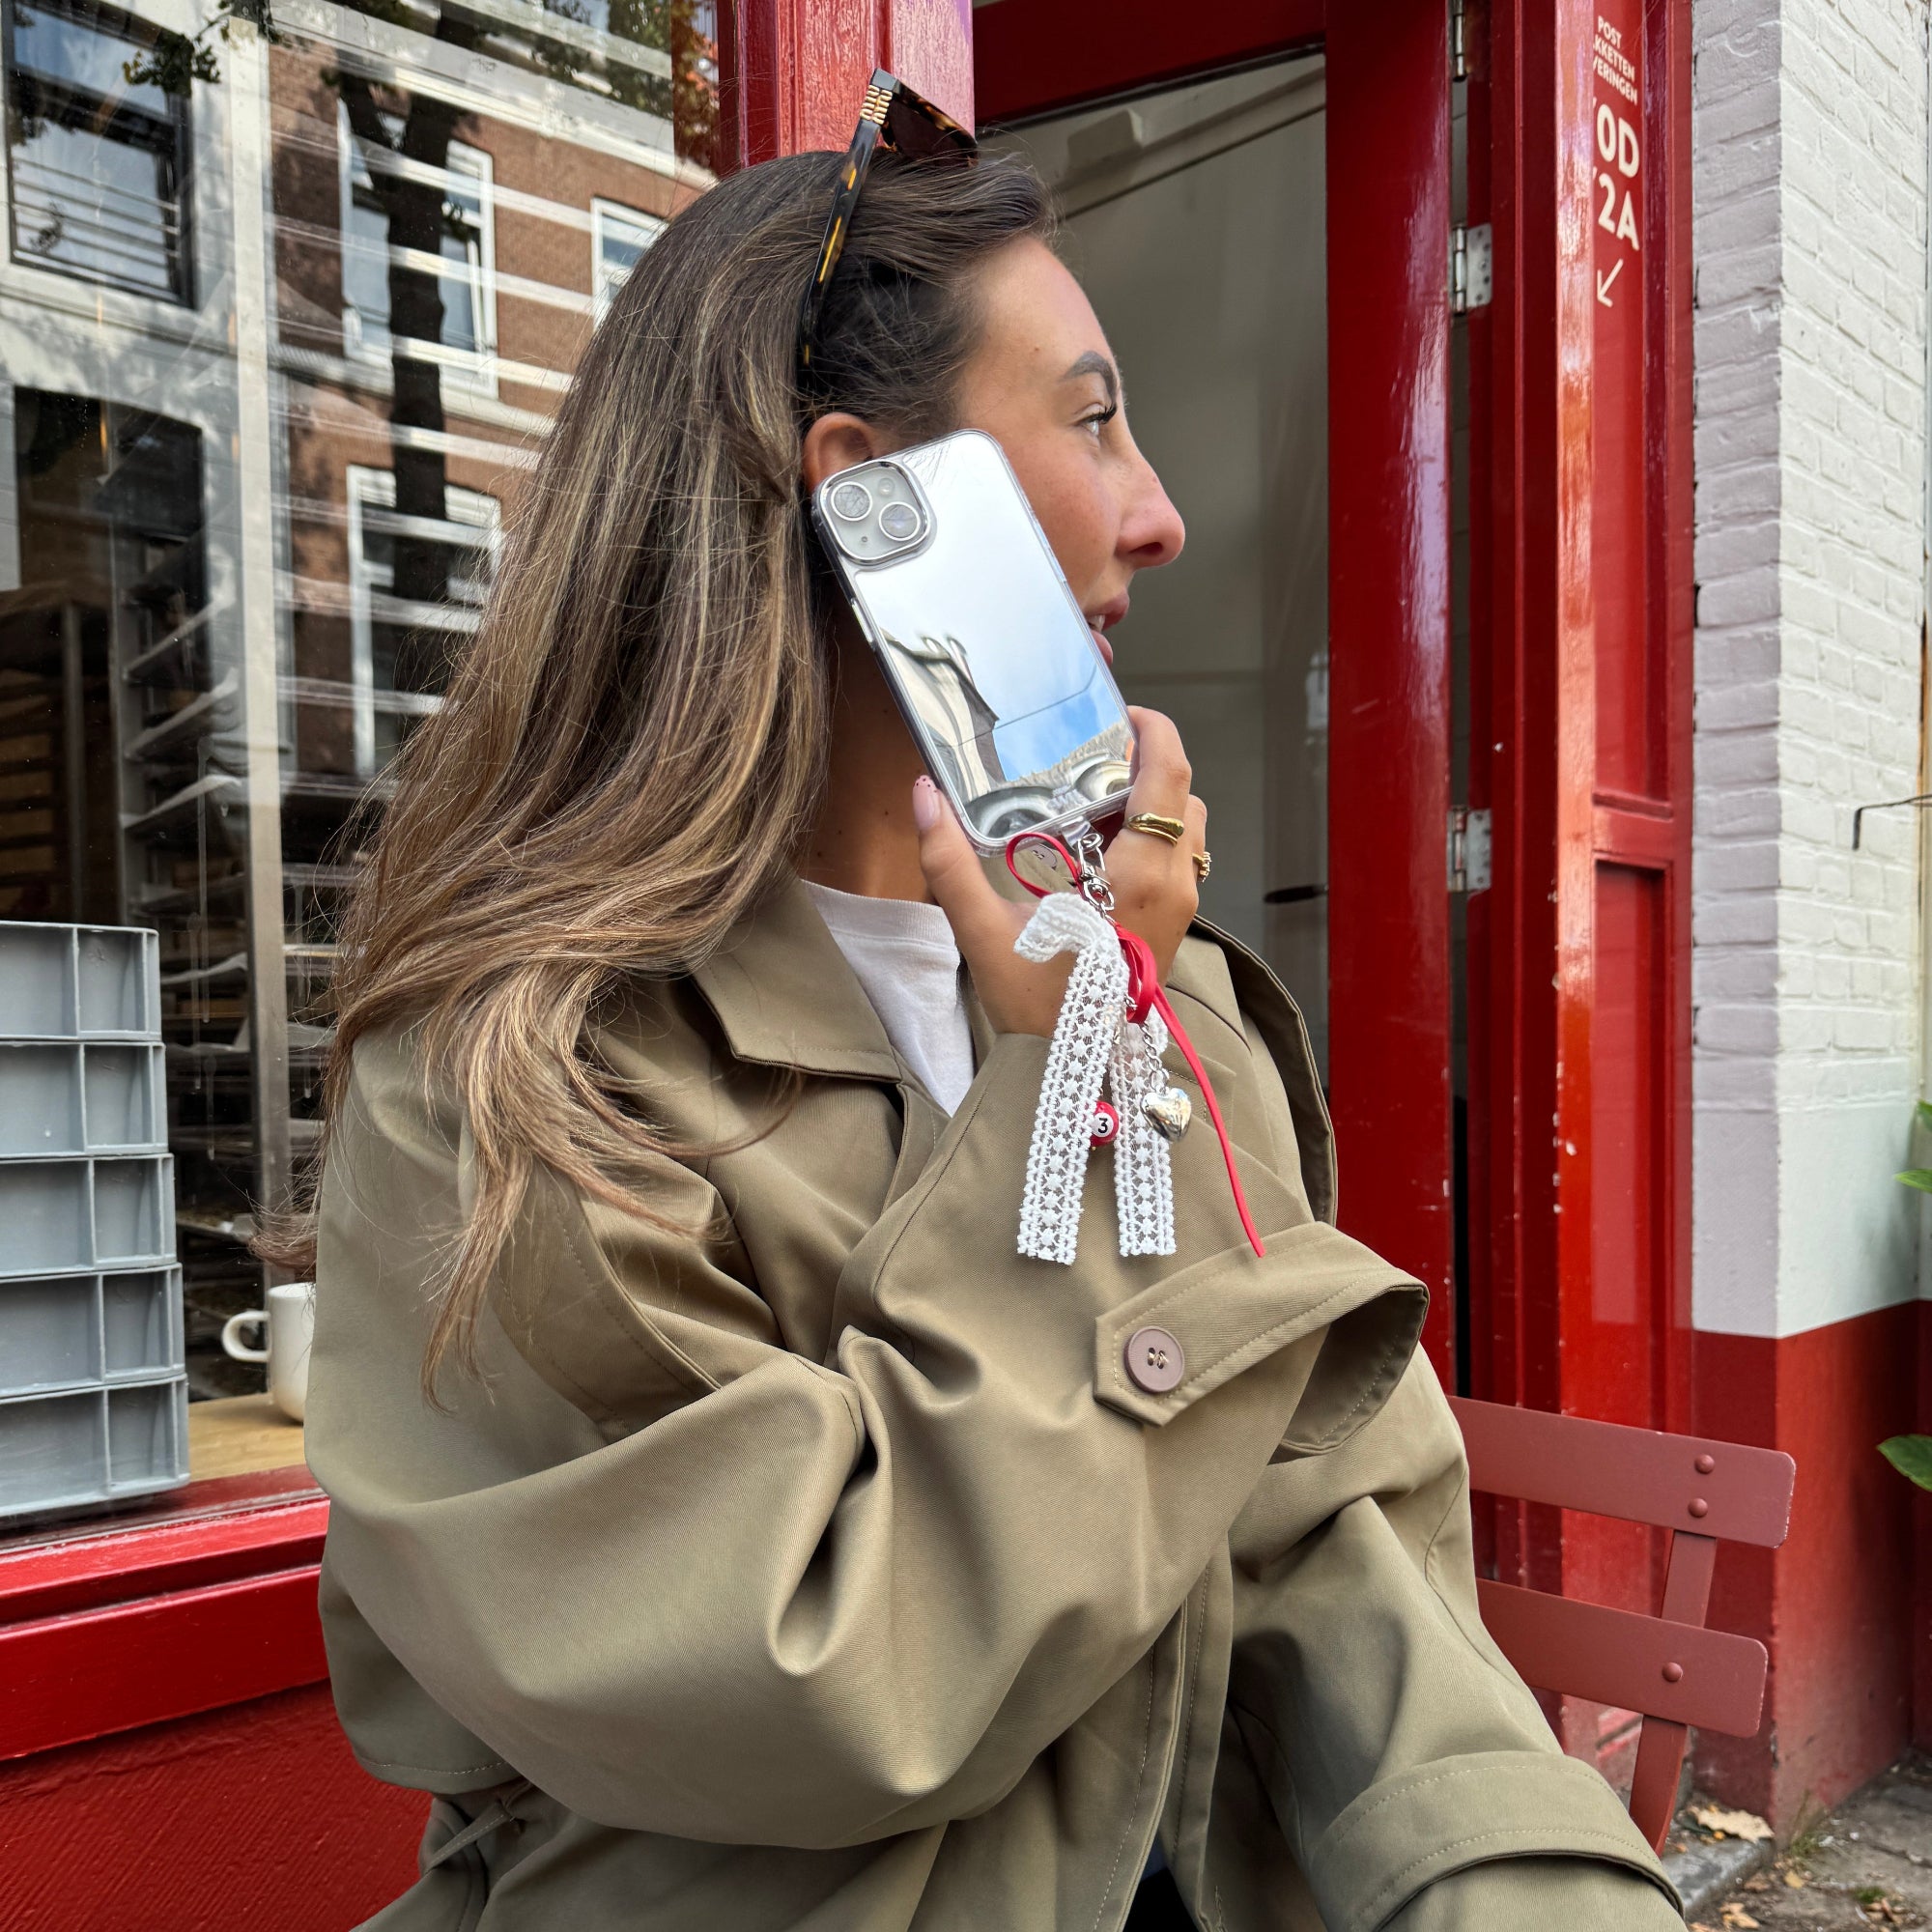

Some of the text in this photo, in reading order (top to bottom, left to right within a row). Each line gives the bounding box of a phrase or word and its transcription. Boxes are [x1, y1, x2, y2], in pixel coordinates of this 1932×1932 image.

[1598, 15, 1622, 49] POST
[1593, 34, 1634, 83] KKETTEN
[1593, 96, 1639, 178] 0D
[1593, 166, 1639, 251] 2A
[1097, 1117, 1108, 1134] 3
